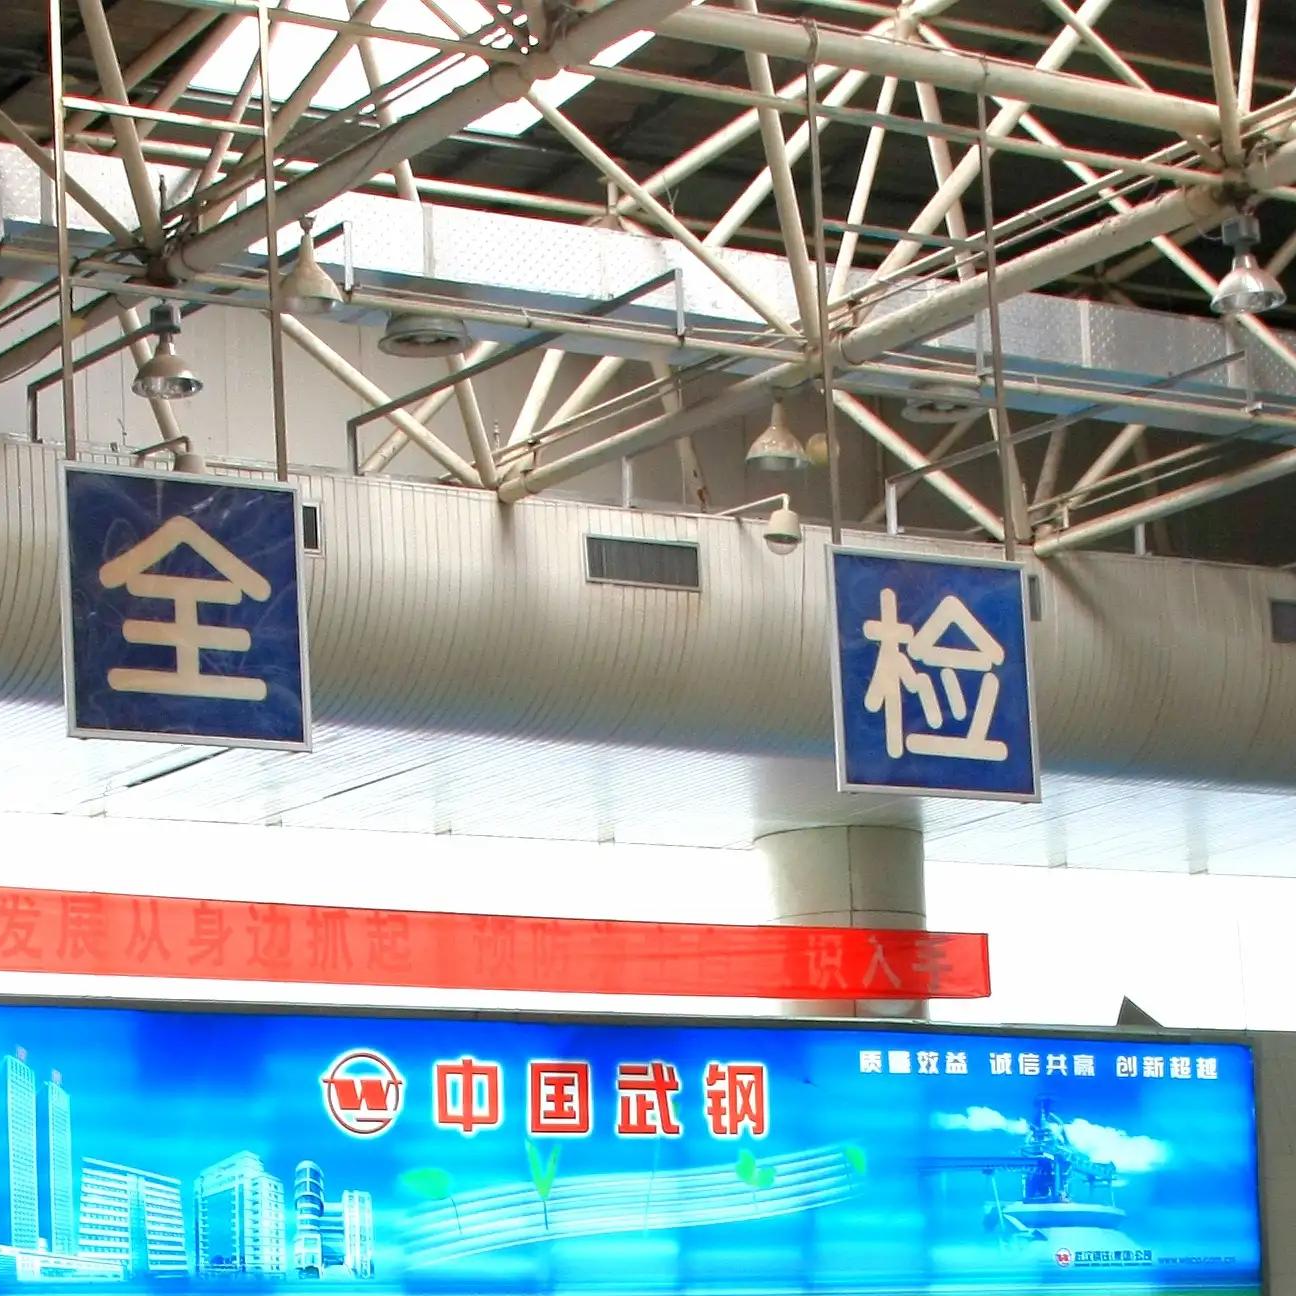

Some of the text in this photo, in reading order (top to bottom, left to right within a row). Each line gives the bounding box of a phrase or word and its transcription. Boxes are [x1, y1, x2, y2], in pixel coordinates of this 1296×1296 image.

[98, 515, 272, 701] 全
[862, 587, 1009, 762] 检
[435, 1057, 771, 1137] 中国武钢
[989, 1052, 1096, 1077] 诚信共赢
[1115, 1055, 1219, 1080] 创新超越
